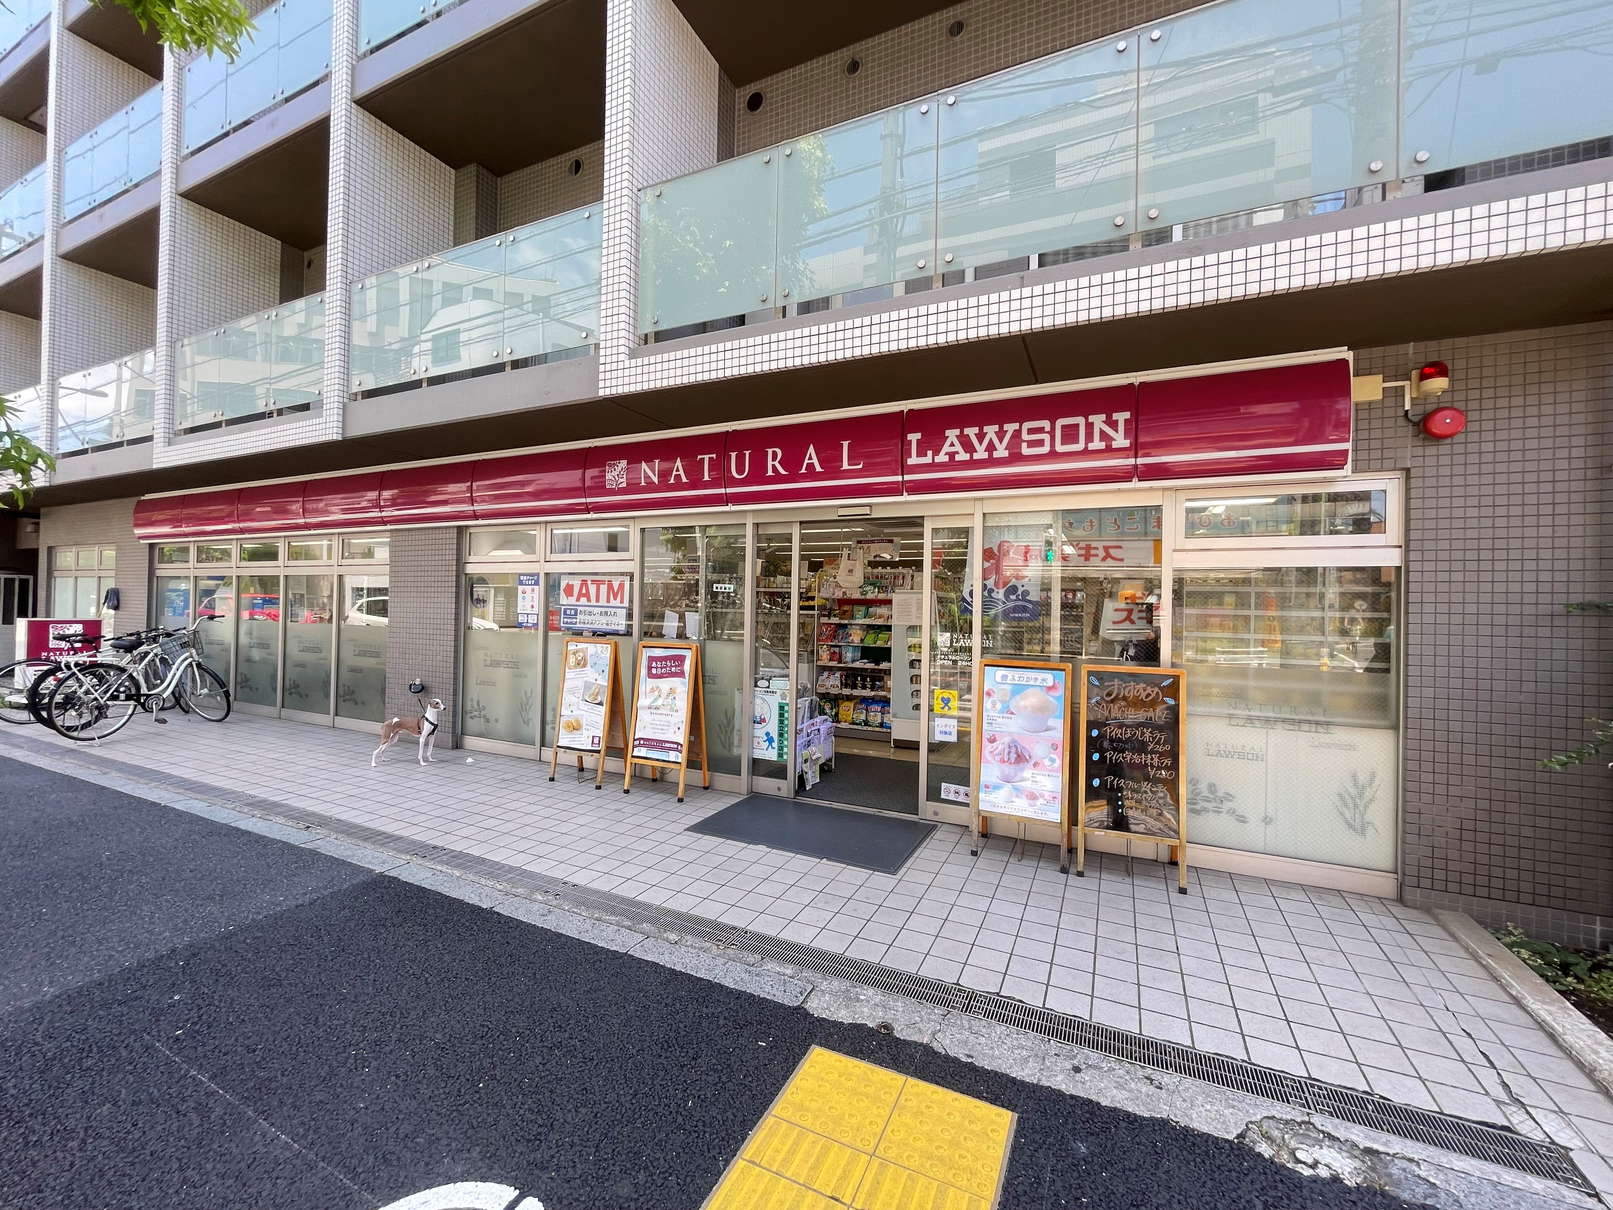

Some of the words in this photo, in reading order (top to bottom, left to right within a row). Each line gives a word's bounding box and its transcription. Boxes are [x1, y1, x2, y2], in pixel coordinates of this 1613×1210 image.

[639, 440, 863, 486] NATURAL
[907, 412, 1131, 465] LAWSON
[575, 579, 625, 604] ATM
